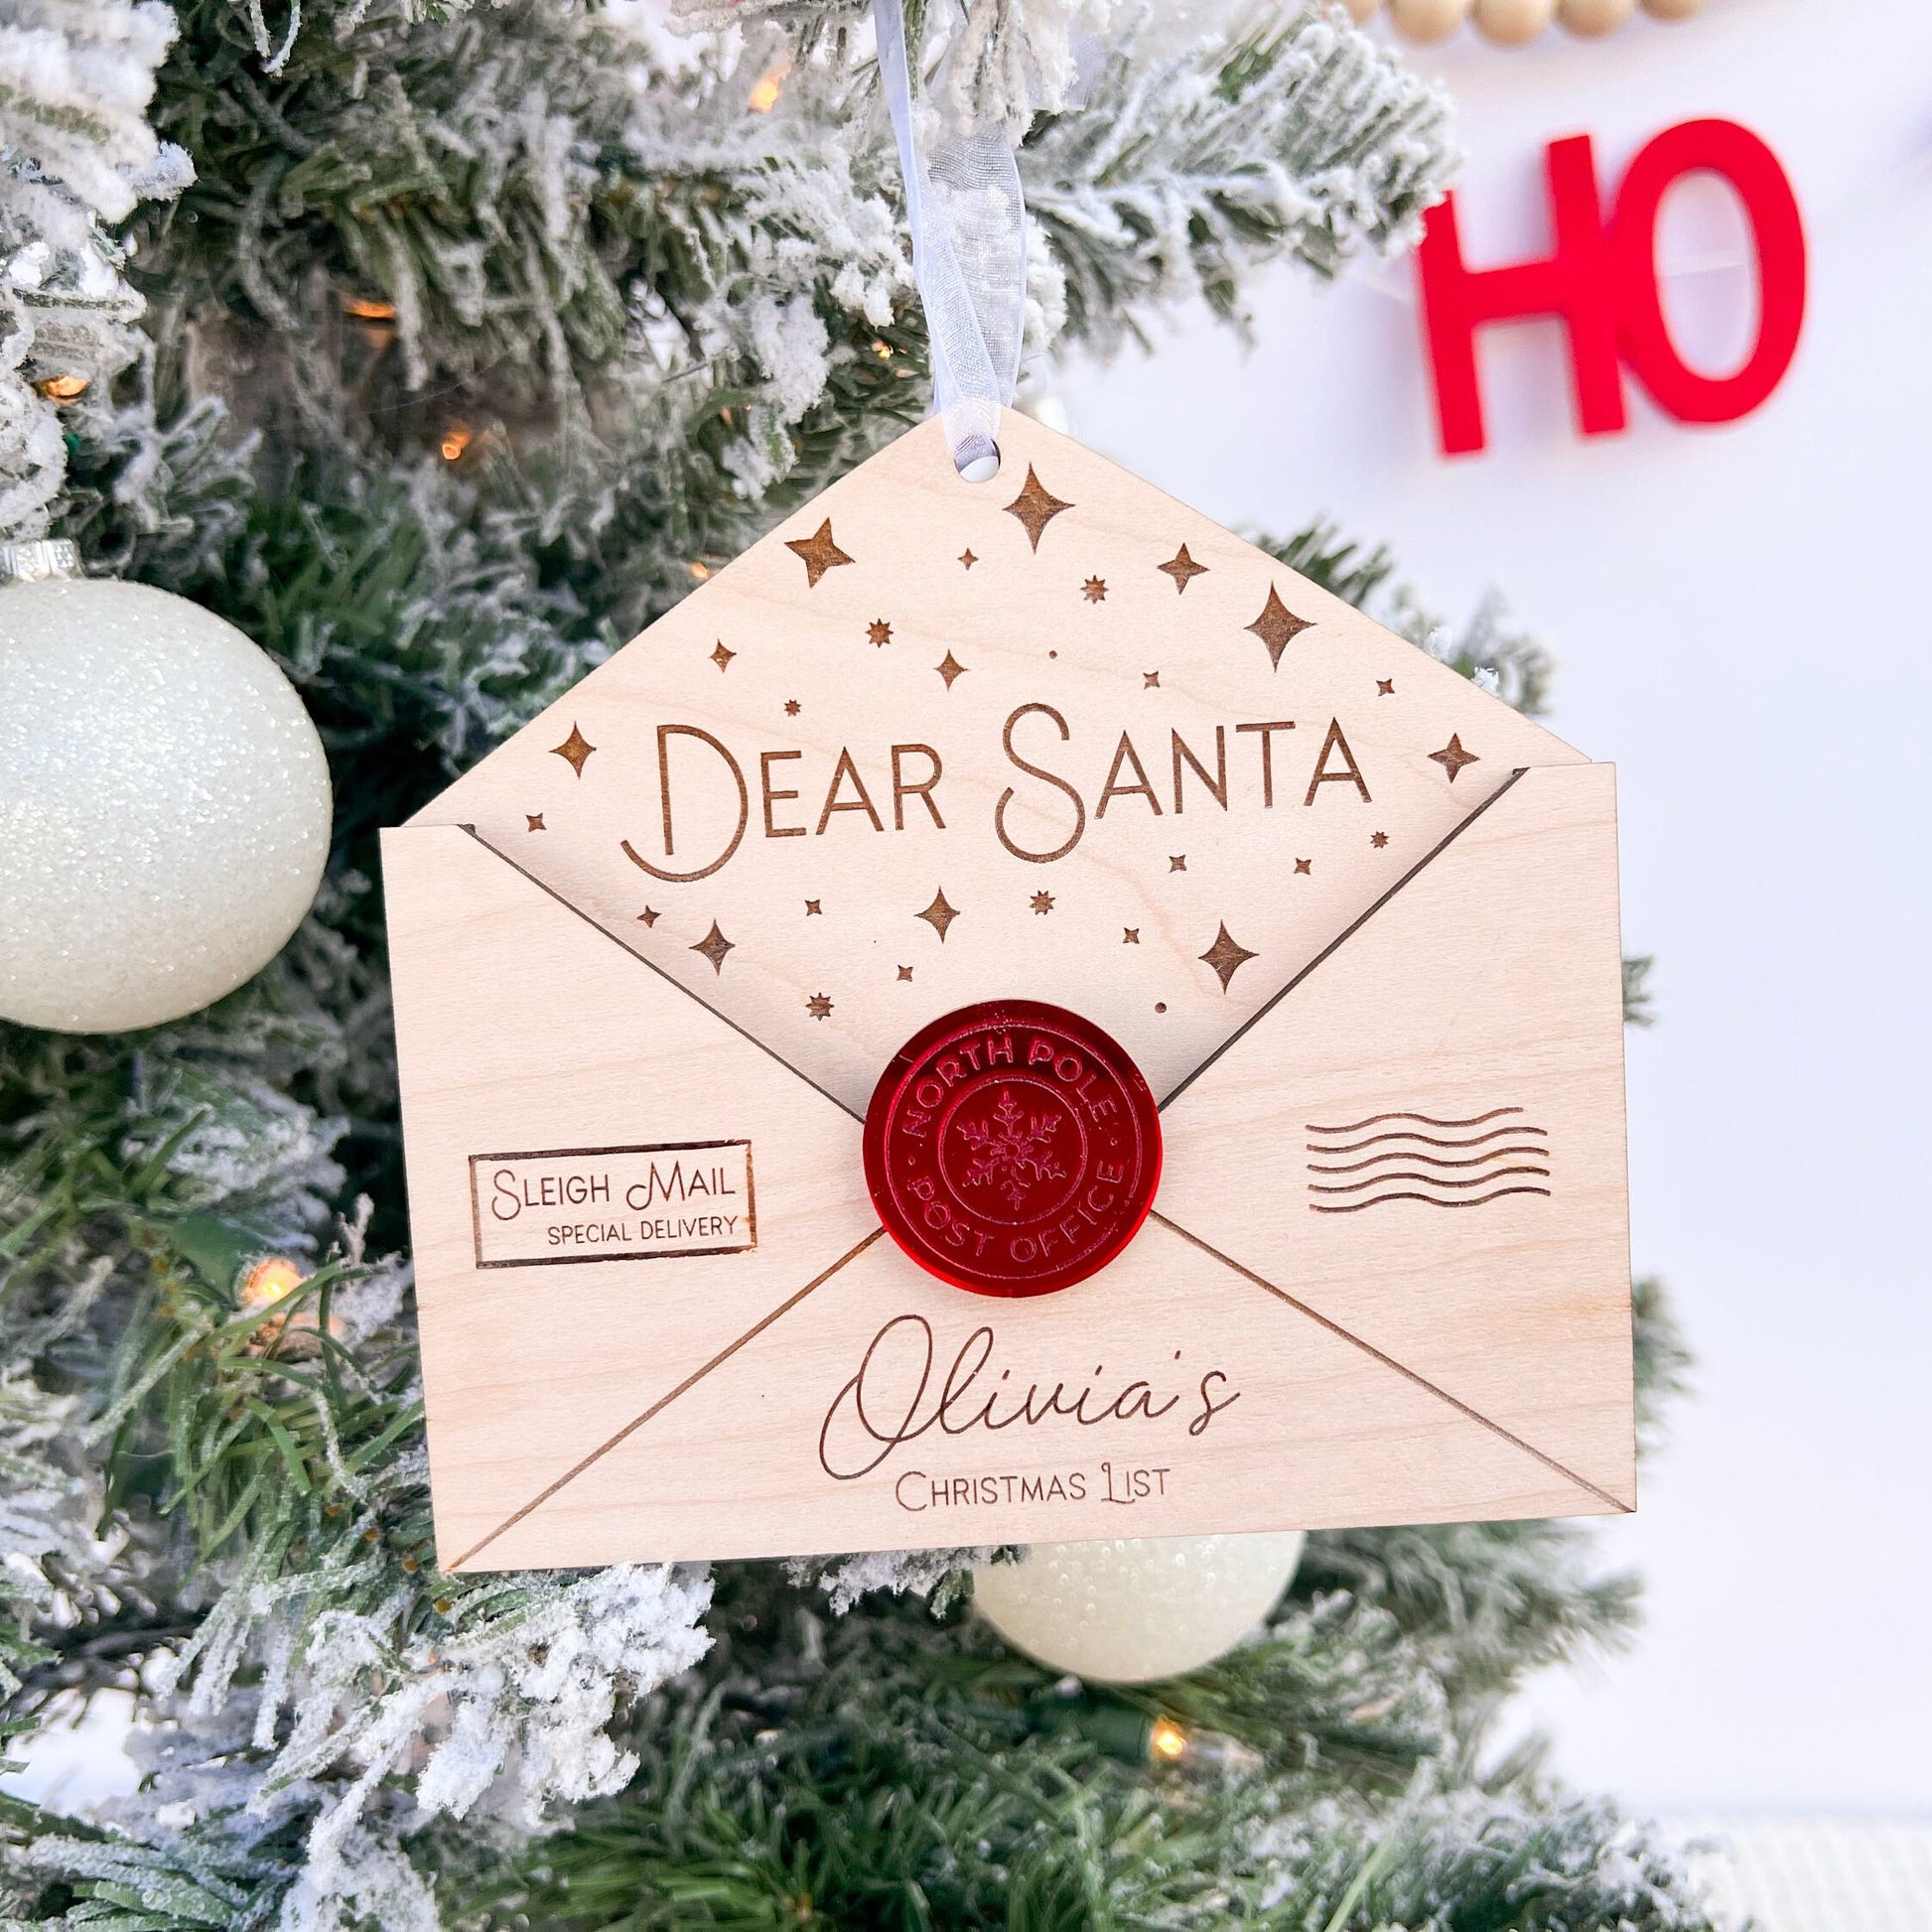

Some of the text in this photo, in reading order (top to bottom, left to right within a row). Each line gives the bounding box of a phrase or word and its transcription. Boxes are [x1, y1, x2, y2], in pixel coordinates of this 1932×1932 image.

[1416, 118, 1807, 457] HO
[901, 1037, 1118, 1138] NORTH POLE
[547, 1215, 739, 1245] SPECIAL DELIVERY
[906, 1161, 1124, 1263] POST OFFICE
[819, 1313, 1241, 1480] Olivia's
